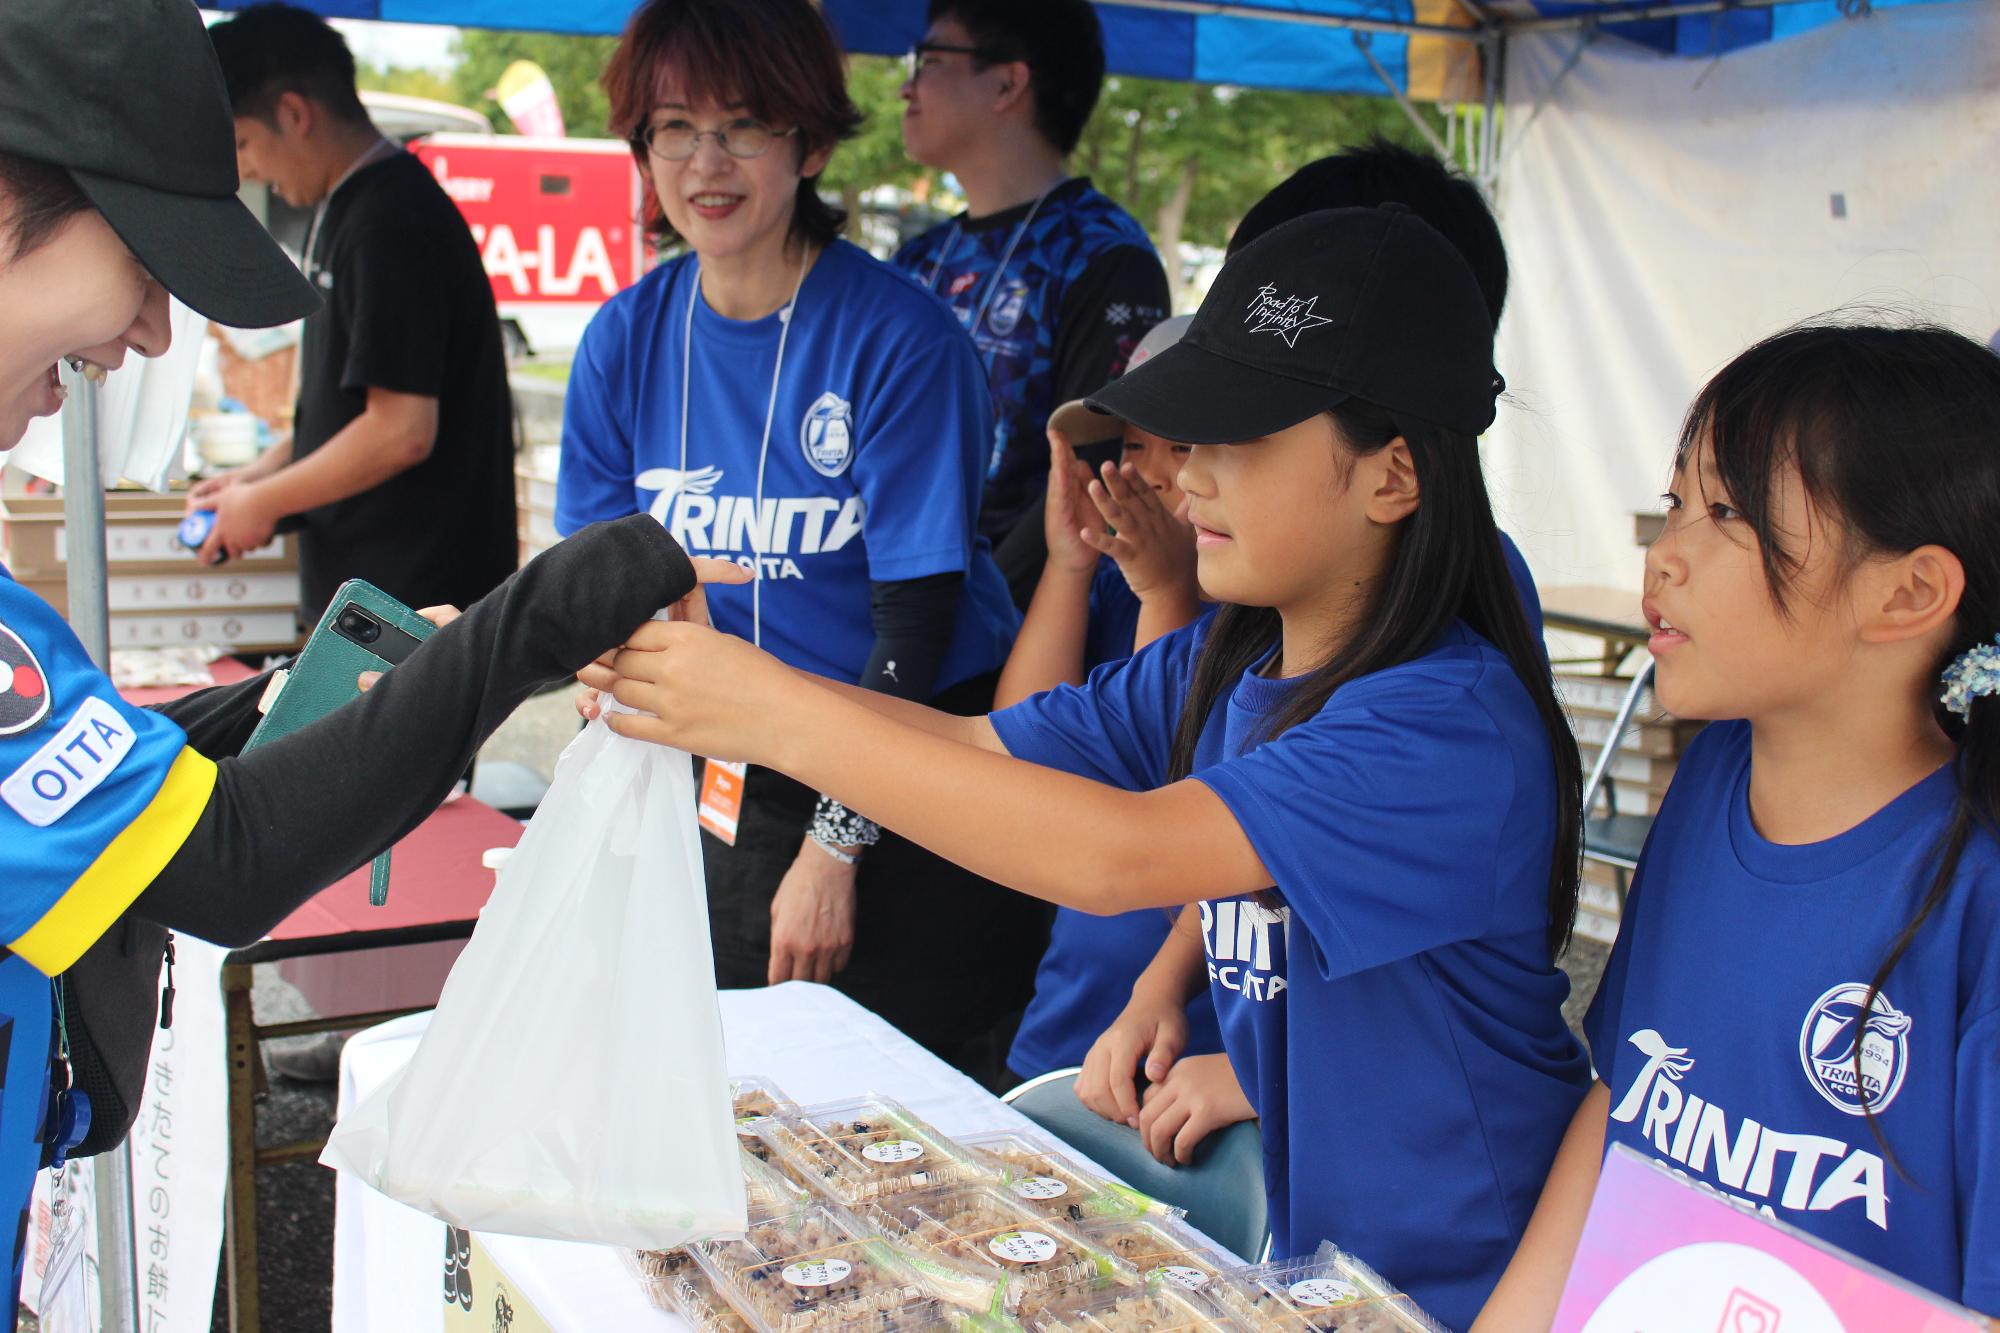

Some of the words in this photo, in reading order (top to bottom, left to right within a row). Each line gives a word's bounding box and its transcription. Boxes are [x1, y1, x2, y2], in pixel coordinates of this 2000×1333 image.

[1247, 282, 1295, 310] Road
[634, 465, 866, 554] TRINITA
[32, 718, 122, 800] OITA
[1610, 1029, 1890, 1231] TRINITA
[1845, 1087, 1870, 1099] OIA
